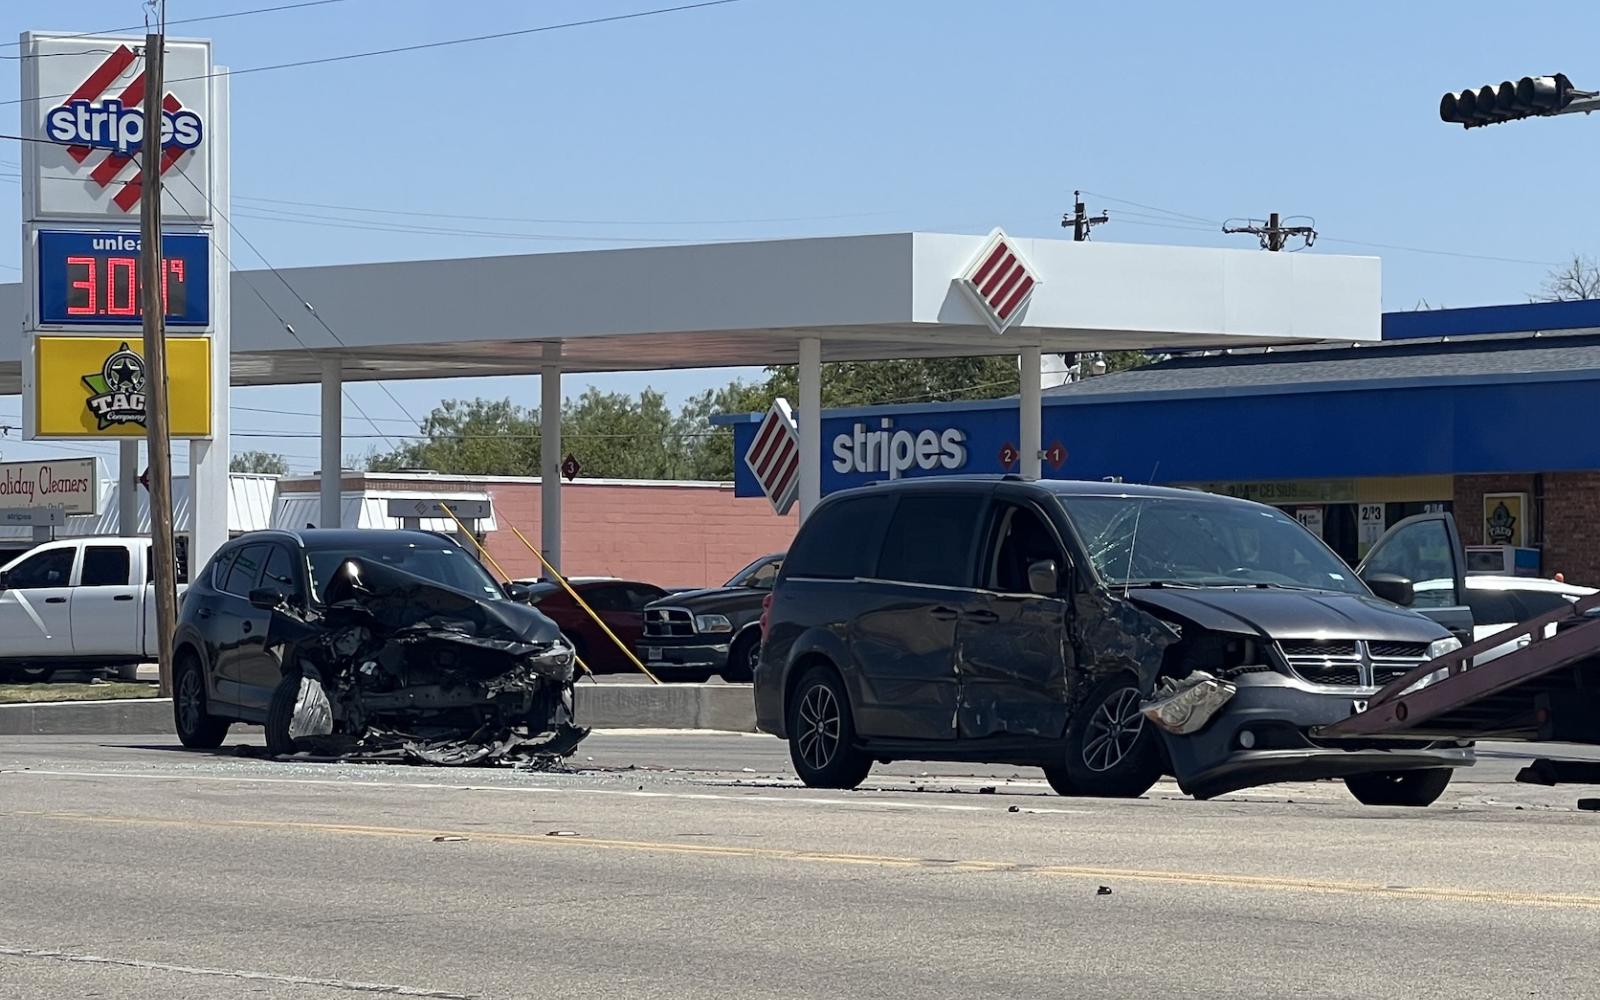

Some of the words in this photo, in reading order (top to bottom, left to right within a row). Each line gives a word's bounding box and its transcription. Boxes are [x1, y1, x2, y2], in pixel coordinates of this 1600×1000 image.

[91, 394, 146, 414] TAC
[832, 418, 966, 480] stripes
[1004, 449, 1012, 462] 2
[0, 467, 34, 503] oliday
[39, 465, 88, 495] Cleaners
